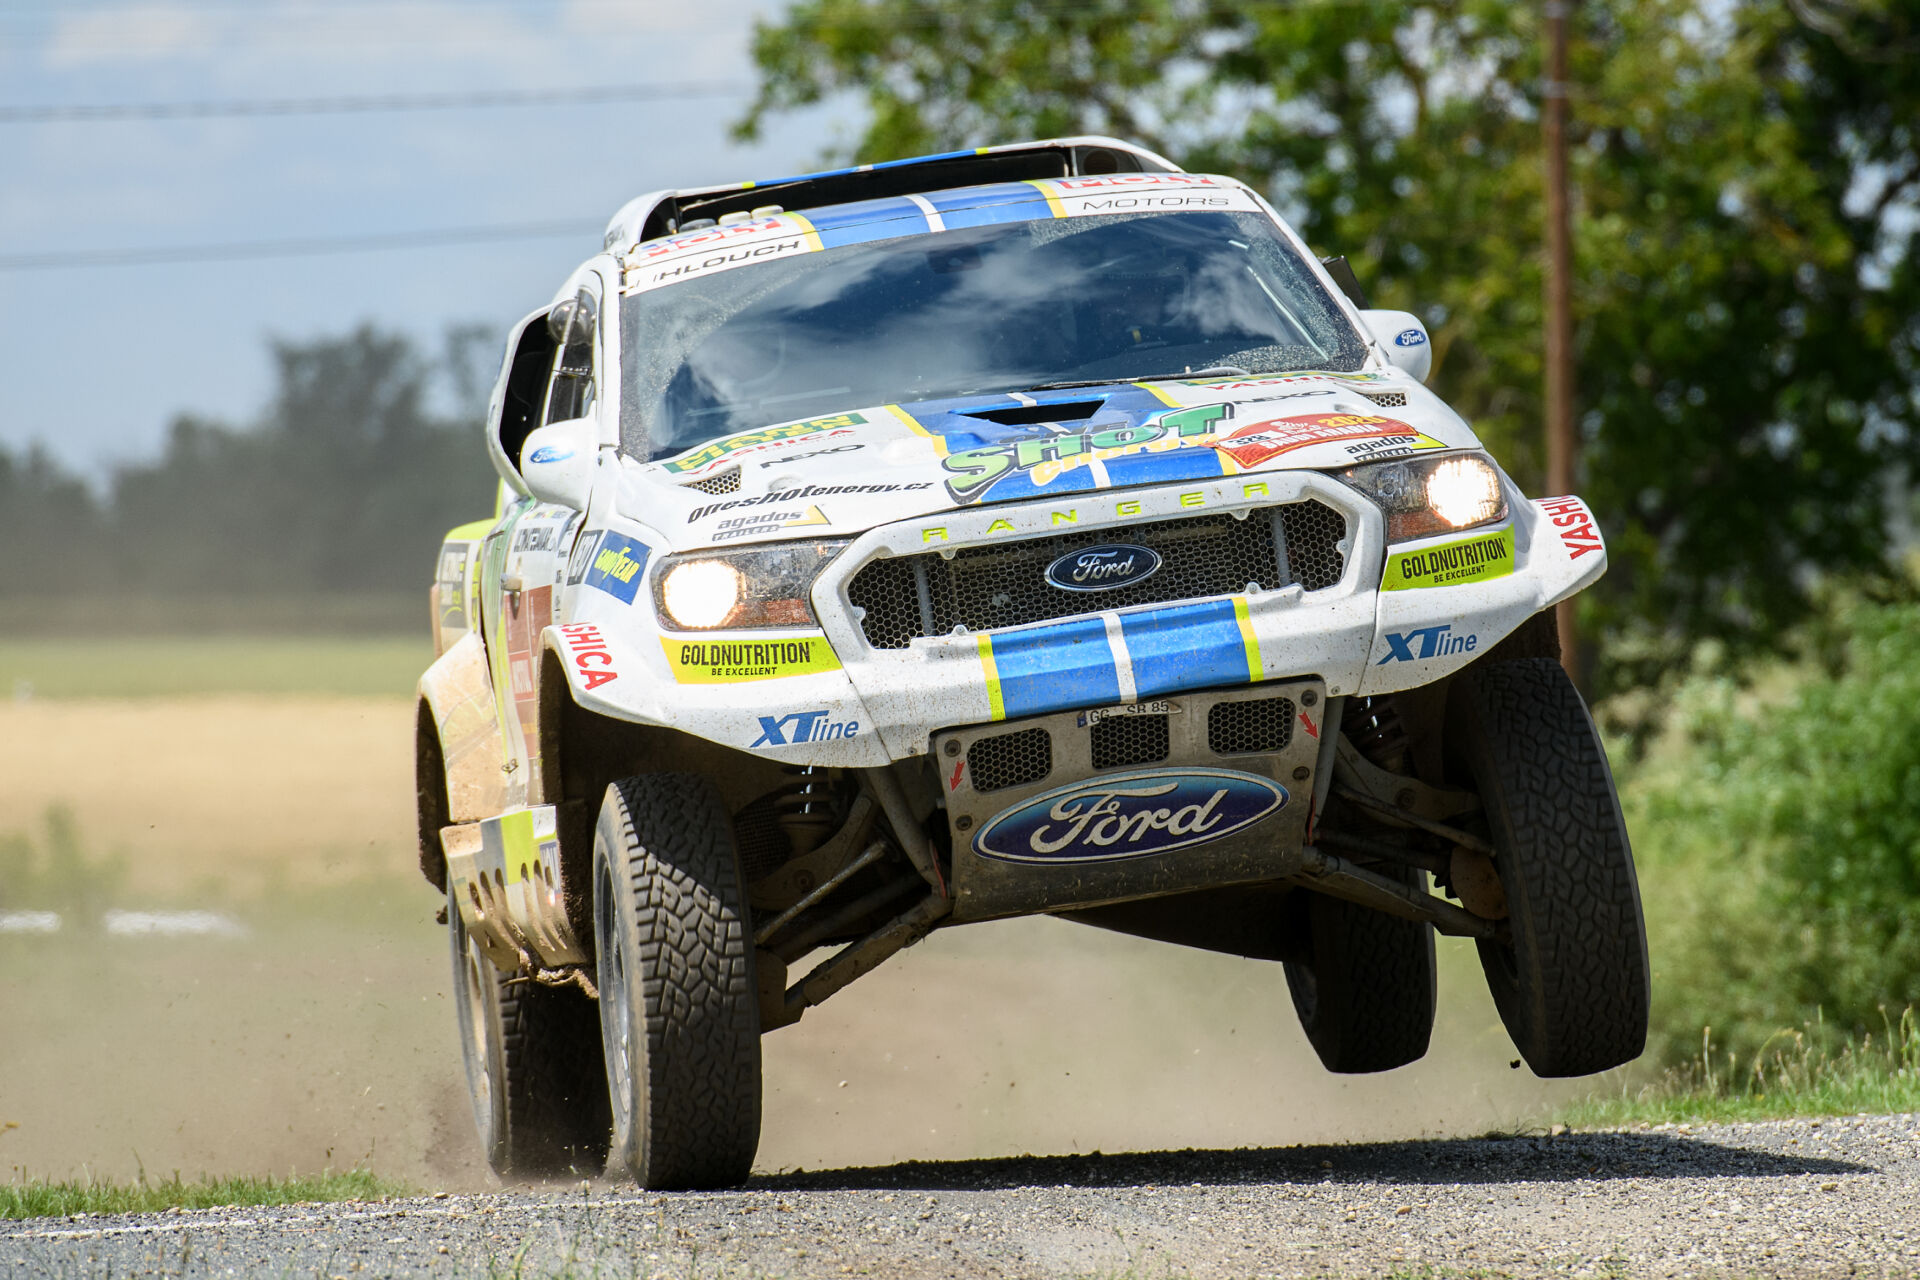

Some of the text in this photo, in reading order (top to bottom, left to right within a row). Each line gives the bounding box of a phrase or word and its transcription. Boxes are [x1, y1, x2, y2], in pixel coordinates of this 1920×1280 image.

[1083, 197, 1229, 210] MOTORS
[1401, 330, 1424, 346] Ford
[1317, 415, 1387, 428] 2020
[942, 402, 1235, 505] SHOT
[1344, 434, 1416, 454] agados
[759, 444, 865, 469] NEXO
[687, 482, 935, 524] oneshotenergy.cz
[923, 482, 1270, 543] RANGER
[718, 511, 804, 530] agados
[1072, 552, 1135, 582] Ford
[1401, 538, 1507, 580] GOLDNUTRITION
[1434, 565, 1486, 583] BE EXCELLENT
[680, 641, 812, 666] GOLDNUTRITION
[711, 666, 777, 676] BE EXCELLENT
[1151, 701, 1169, 713] 85
[1030, 782, 1230, 853] Ford
